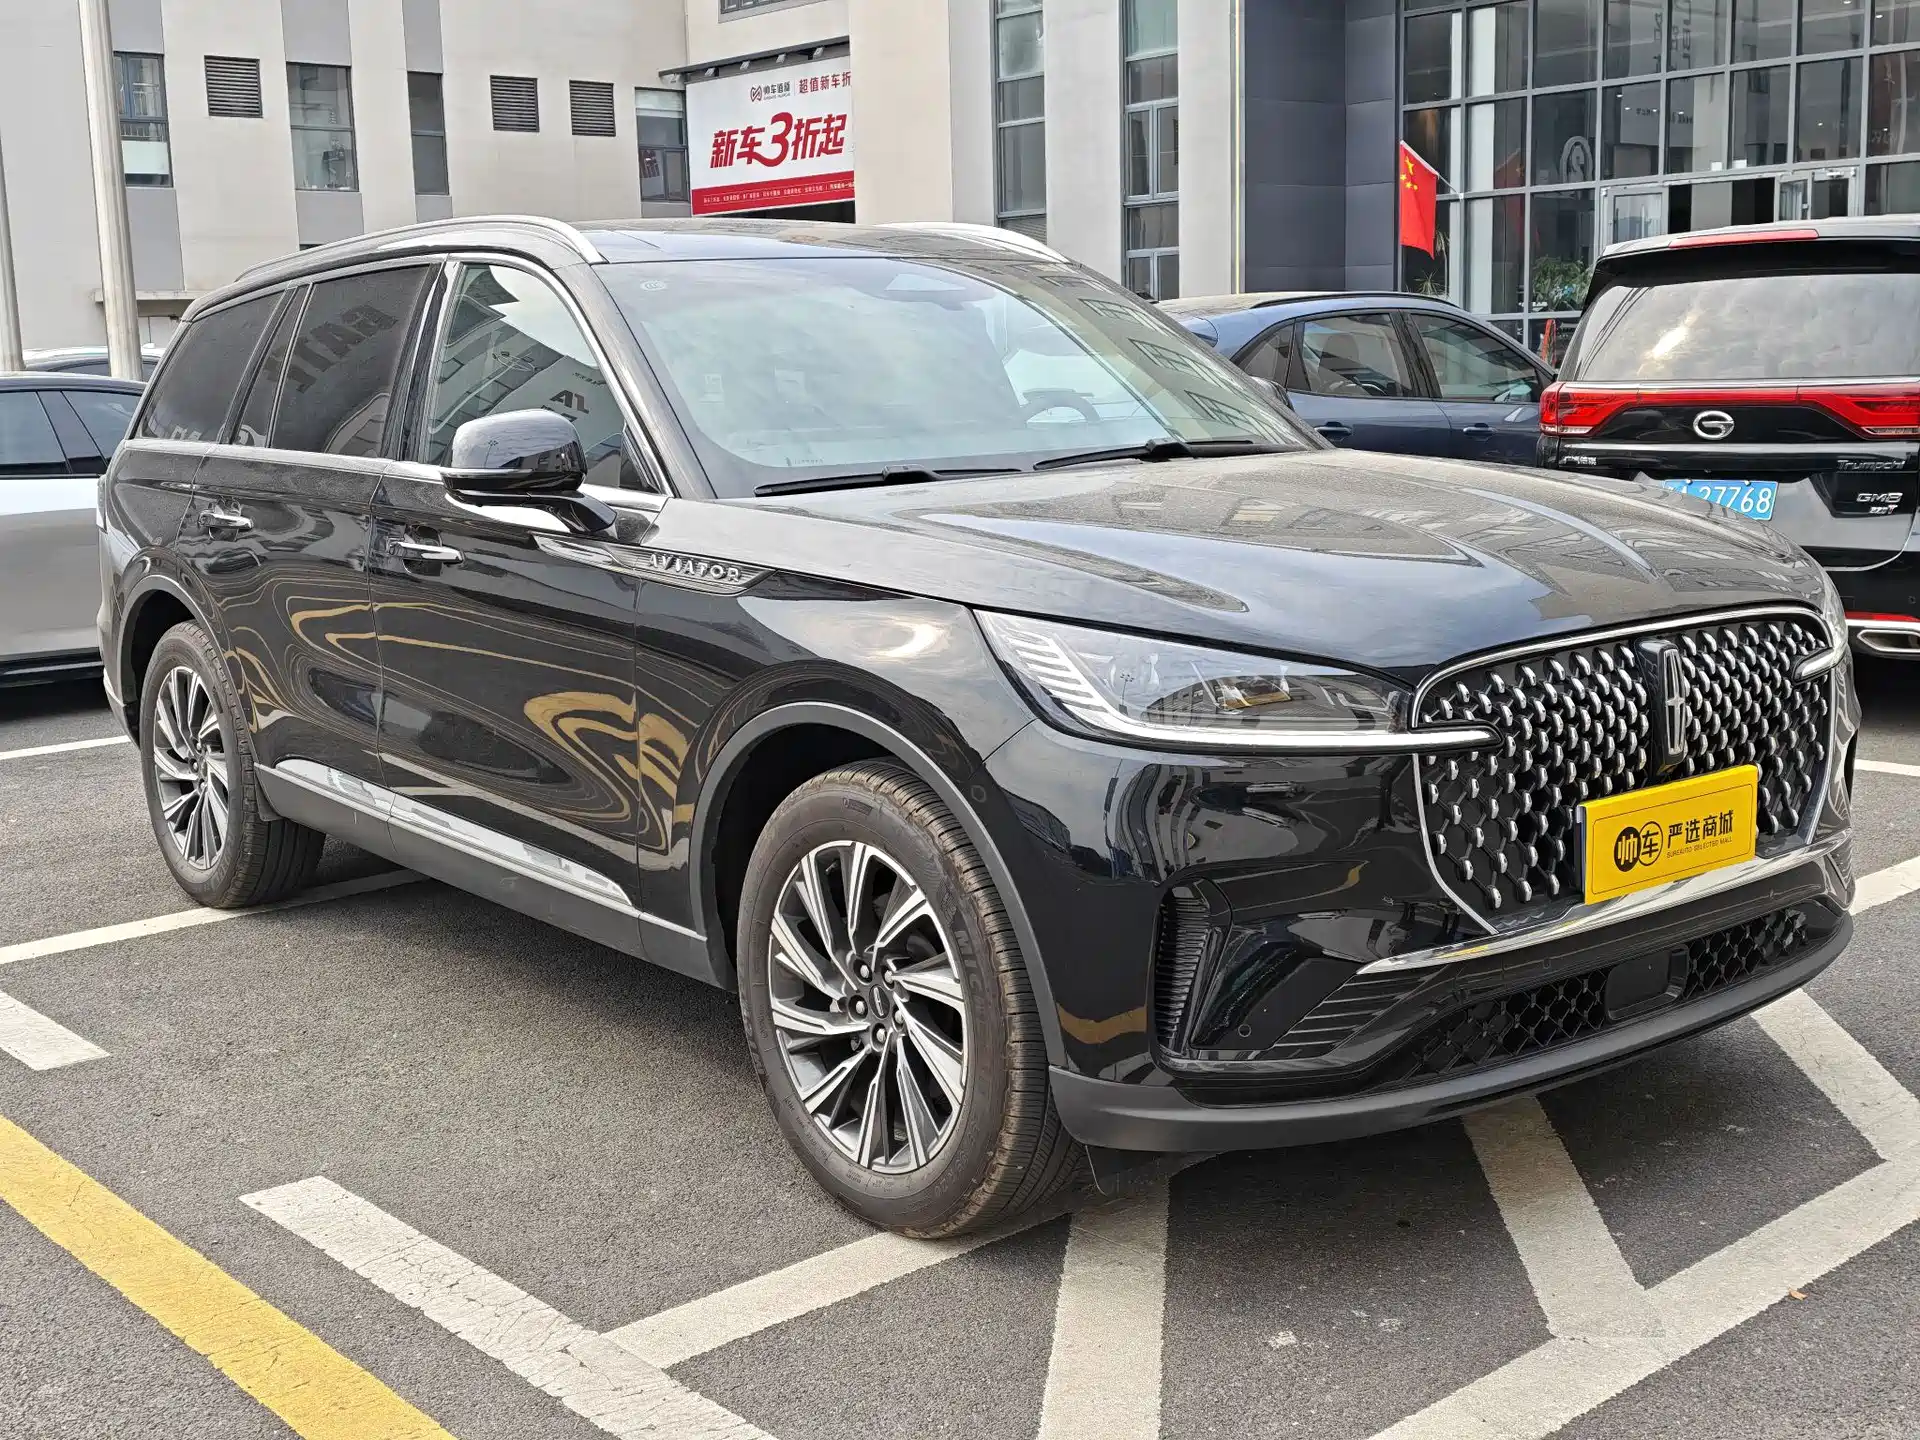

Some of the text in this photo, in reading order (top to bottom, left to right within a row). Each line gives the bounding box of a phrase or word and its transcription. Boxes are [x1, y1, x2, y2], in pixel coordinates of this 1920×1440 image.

[710, 112, 847, 169] 新车3折起
[1837, 460, 1905, 471] Trumpchi
[1856, 492, 1903, 502] GM8
[649, 552, 740, 583] AVIATOR
[1667, 810, 1734, 849] 严选商城
